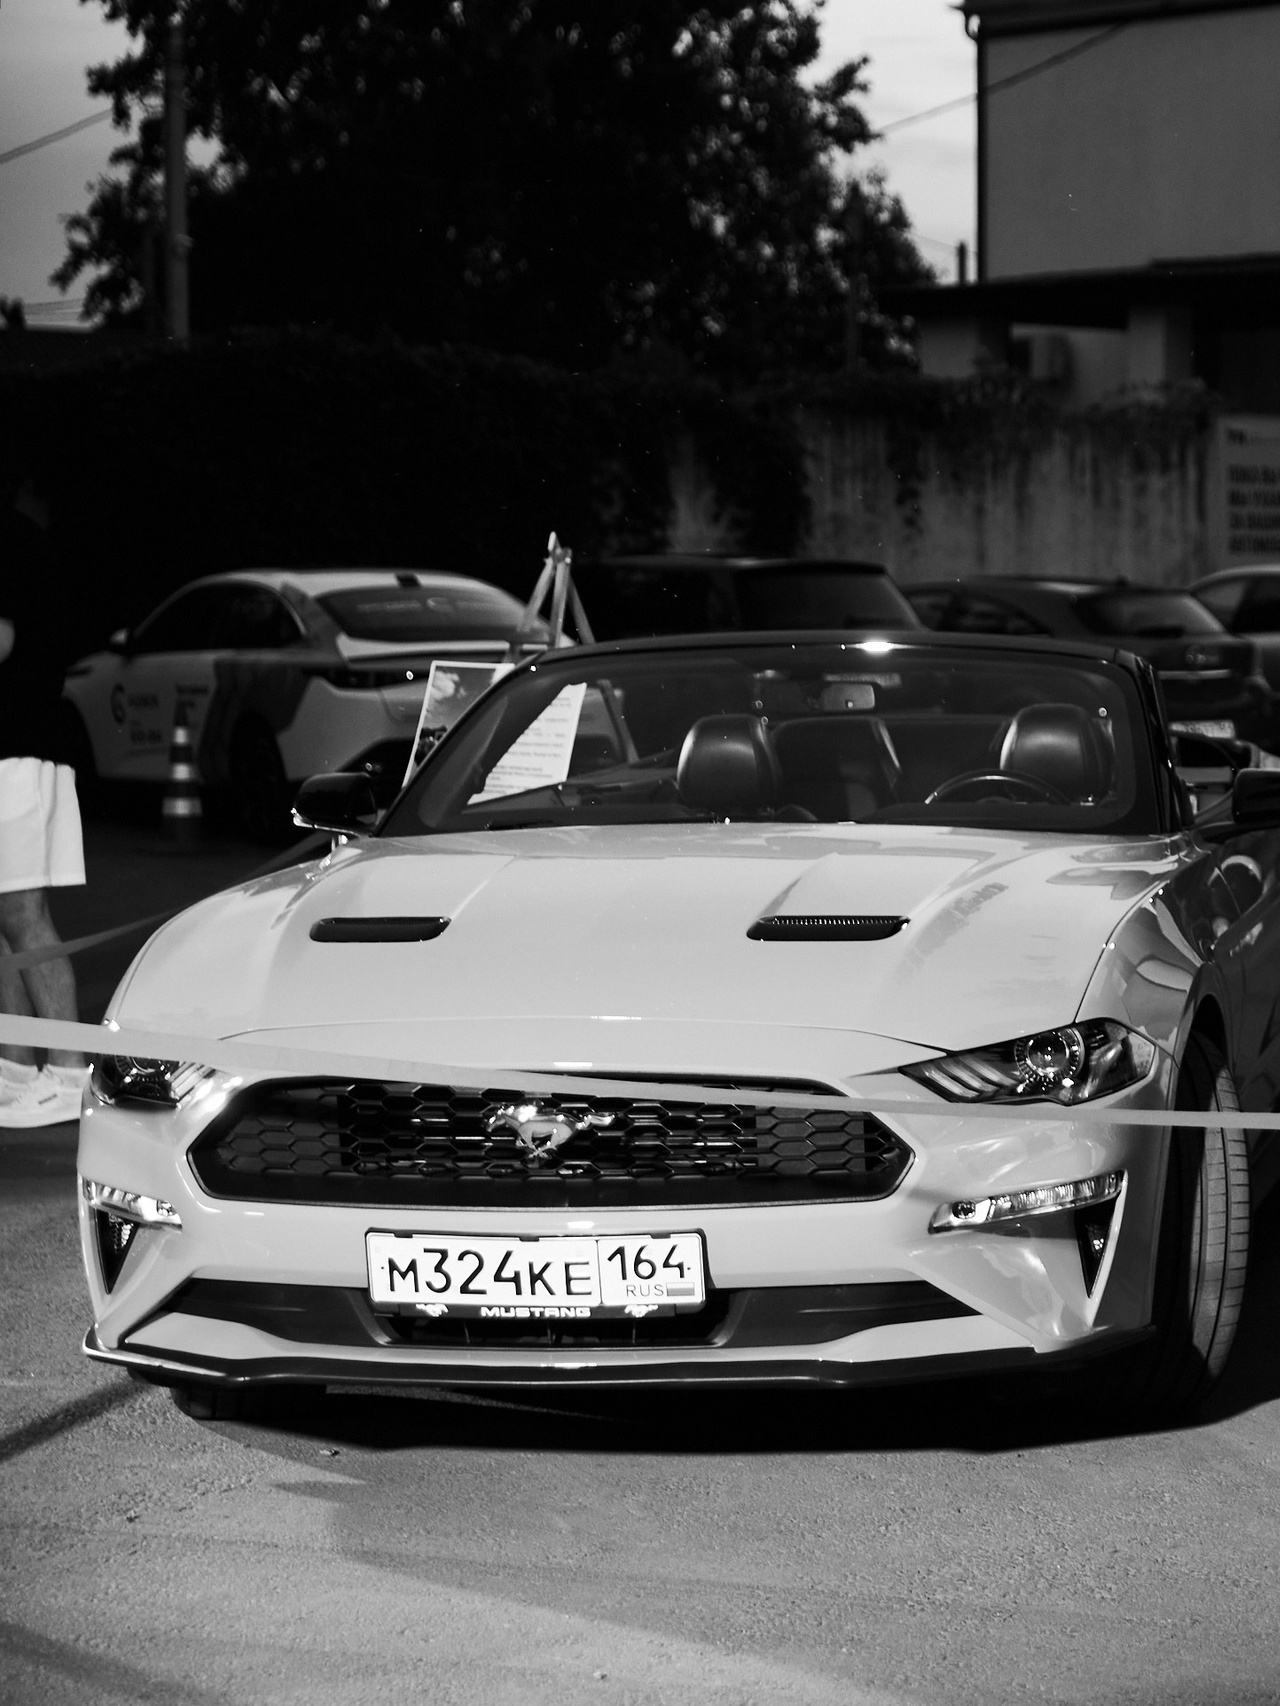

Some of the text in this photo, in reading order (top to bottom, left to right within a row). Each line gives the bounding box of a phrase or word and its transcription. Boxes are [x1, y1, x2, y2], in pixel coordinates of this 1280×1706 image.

[606, 1244, 686, 1281] 164
[626, 1284, 664, 1298] RUS
[480, 1306, 592, 1318] MUSTANG
